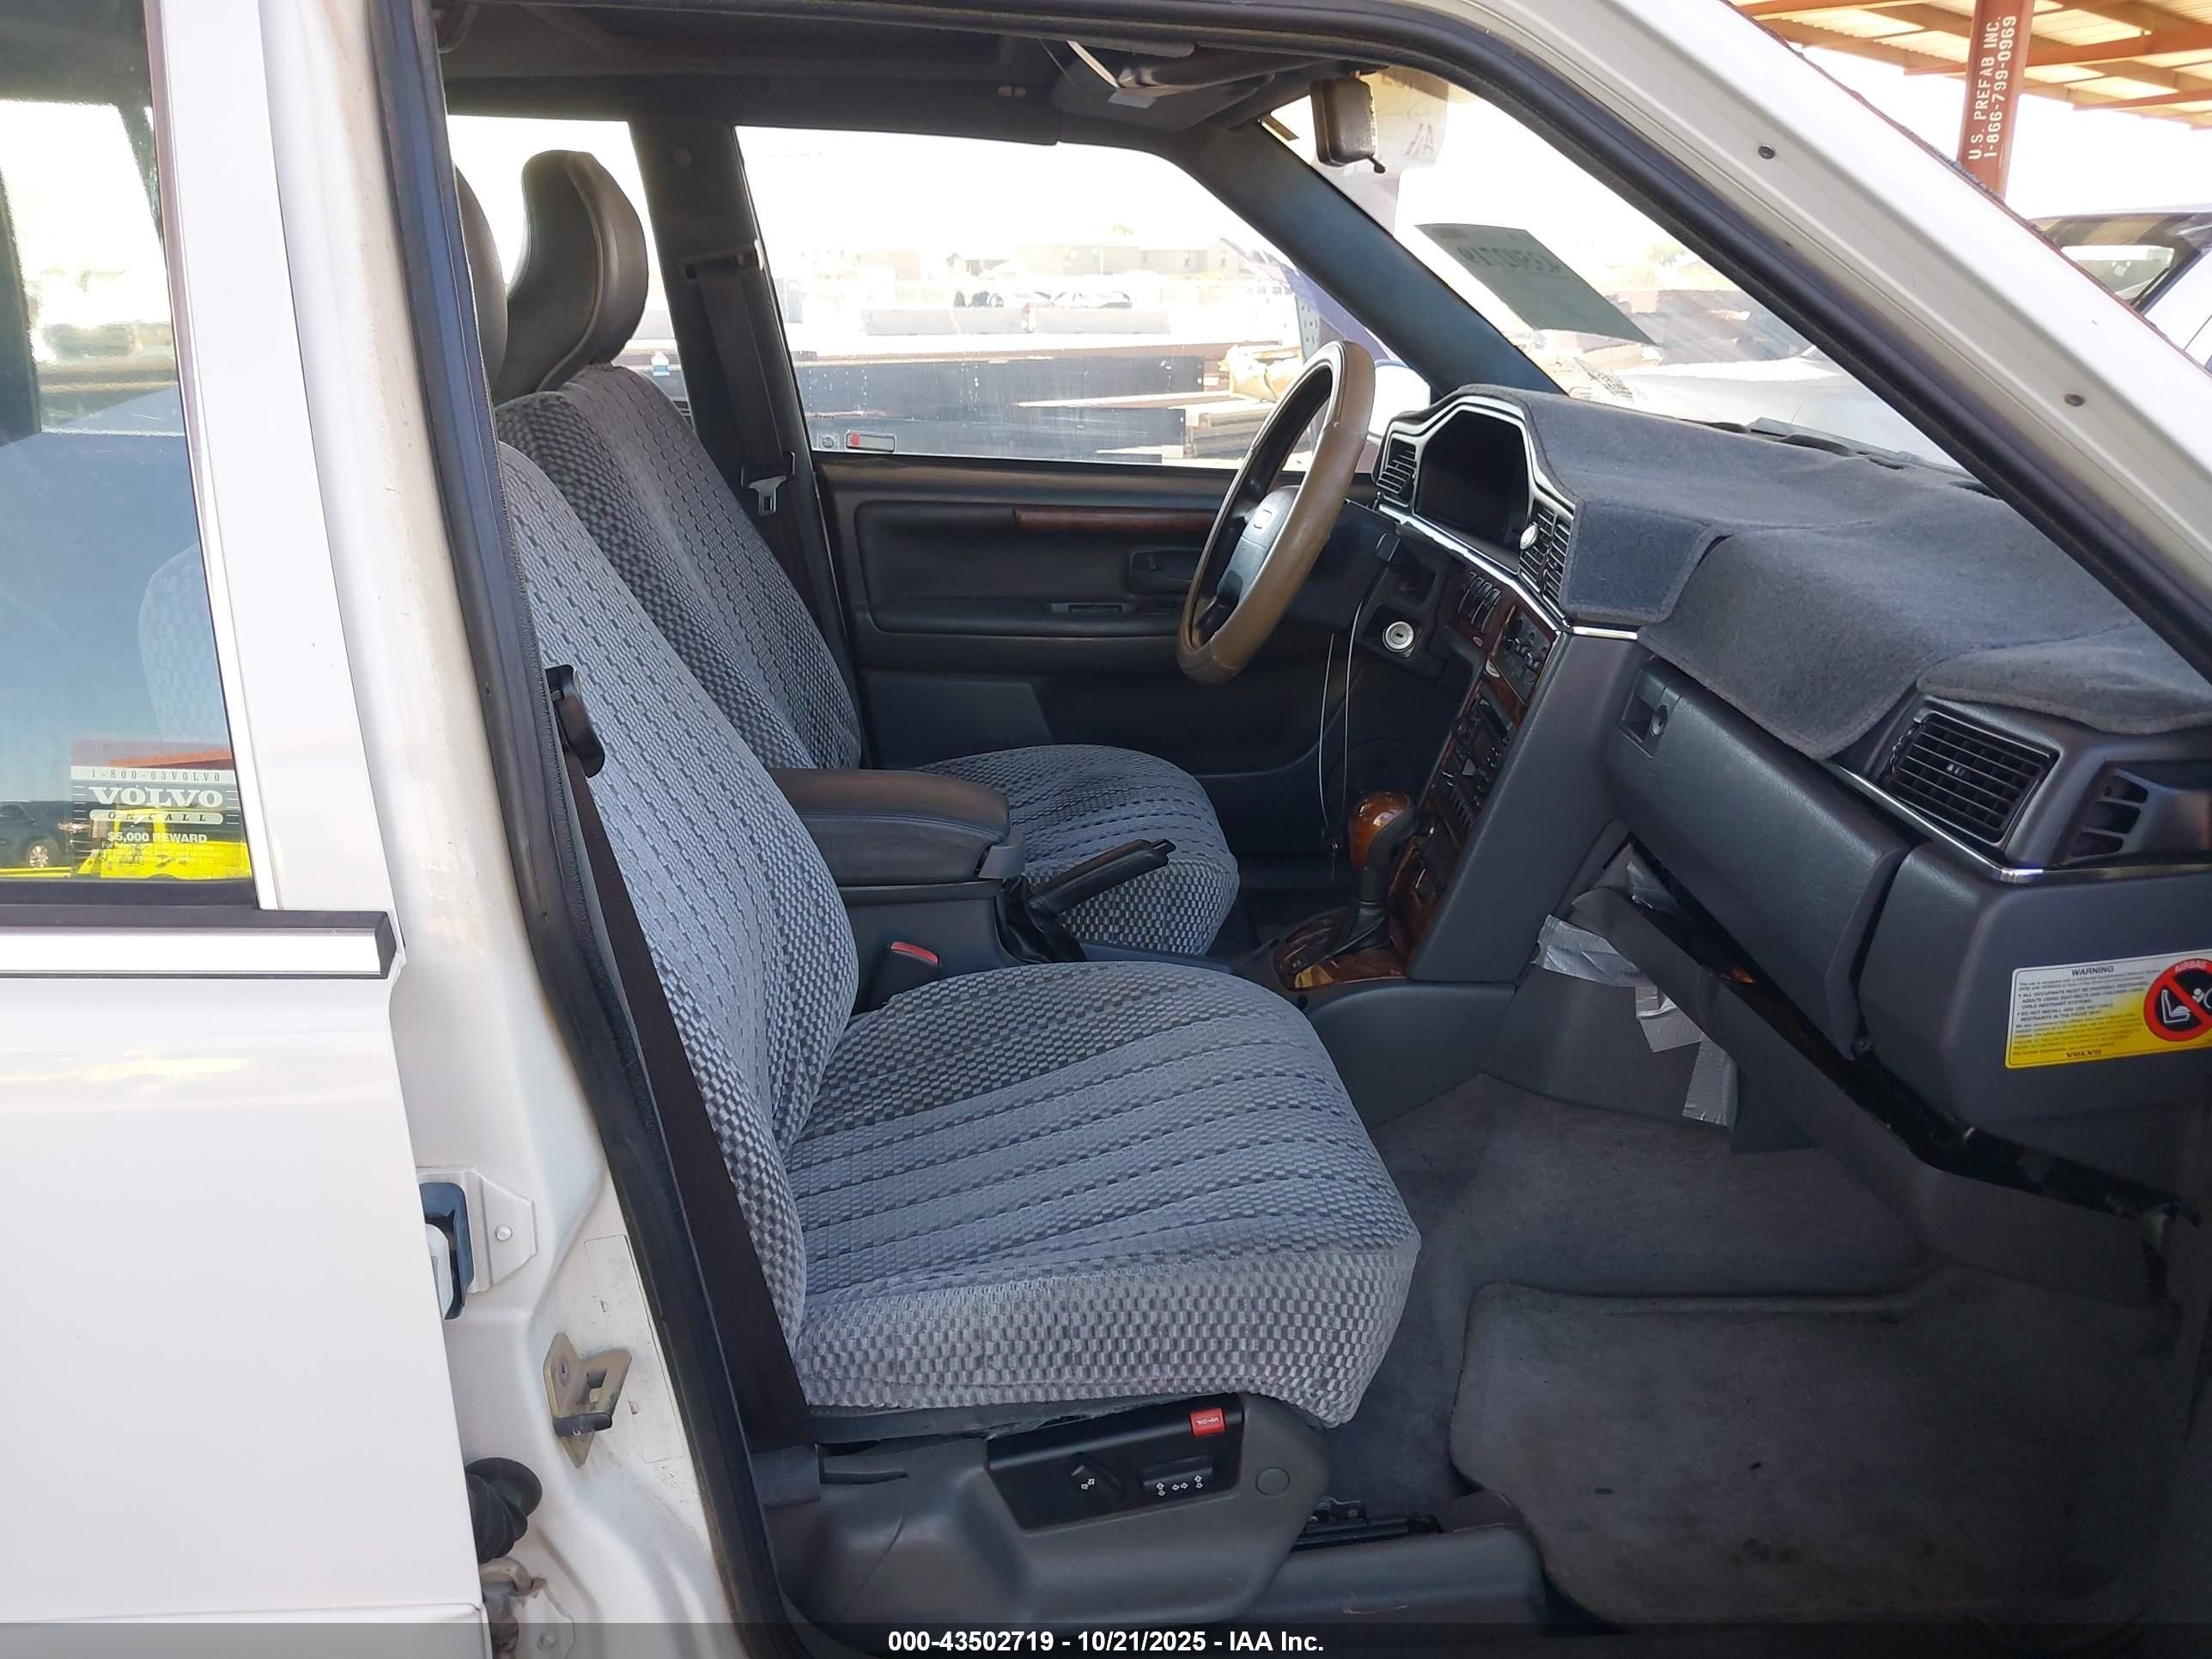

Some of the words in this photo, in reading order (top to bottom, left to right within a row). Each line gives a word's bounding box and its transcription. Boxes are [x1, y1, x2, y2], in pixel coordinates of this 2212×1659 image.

[1984, 16, 2001, 48] INC.
[1974, 56, 1995, 120] PREFAB
[1984, 15, 2017, 157] 1-866-799-0969
[1968, 129, 1985, 160] U.S.
[88, 787, 223, 808] VOLVO
[149, 813, 207, 822] CALL
[107, 831, 150, 843] $5,000
[152, 832, 207, 844] REWARD
[2071, 965, 2114, 976] WARNING
[2065, 1049, 2102, 1058] VOLVO
